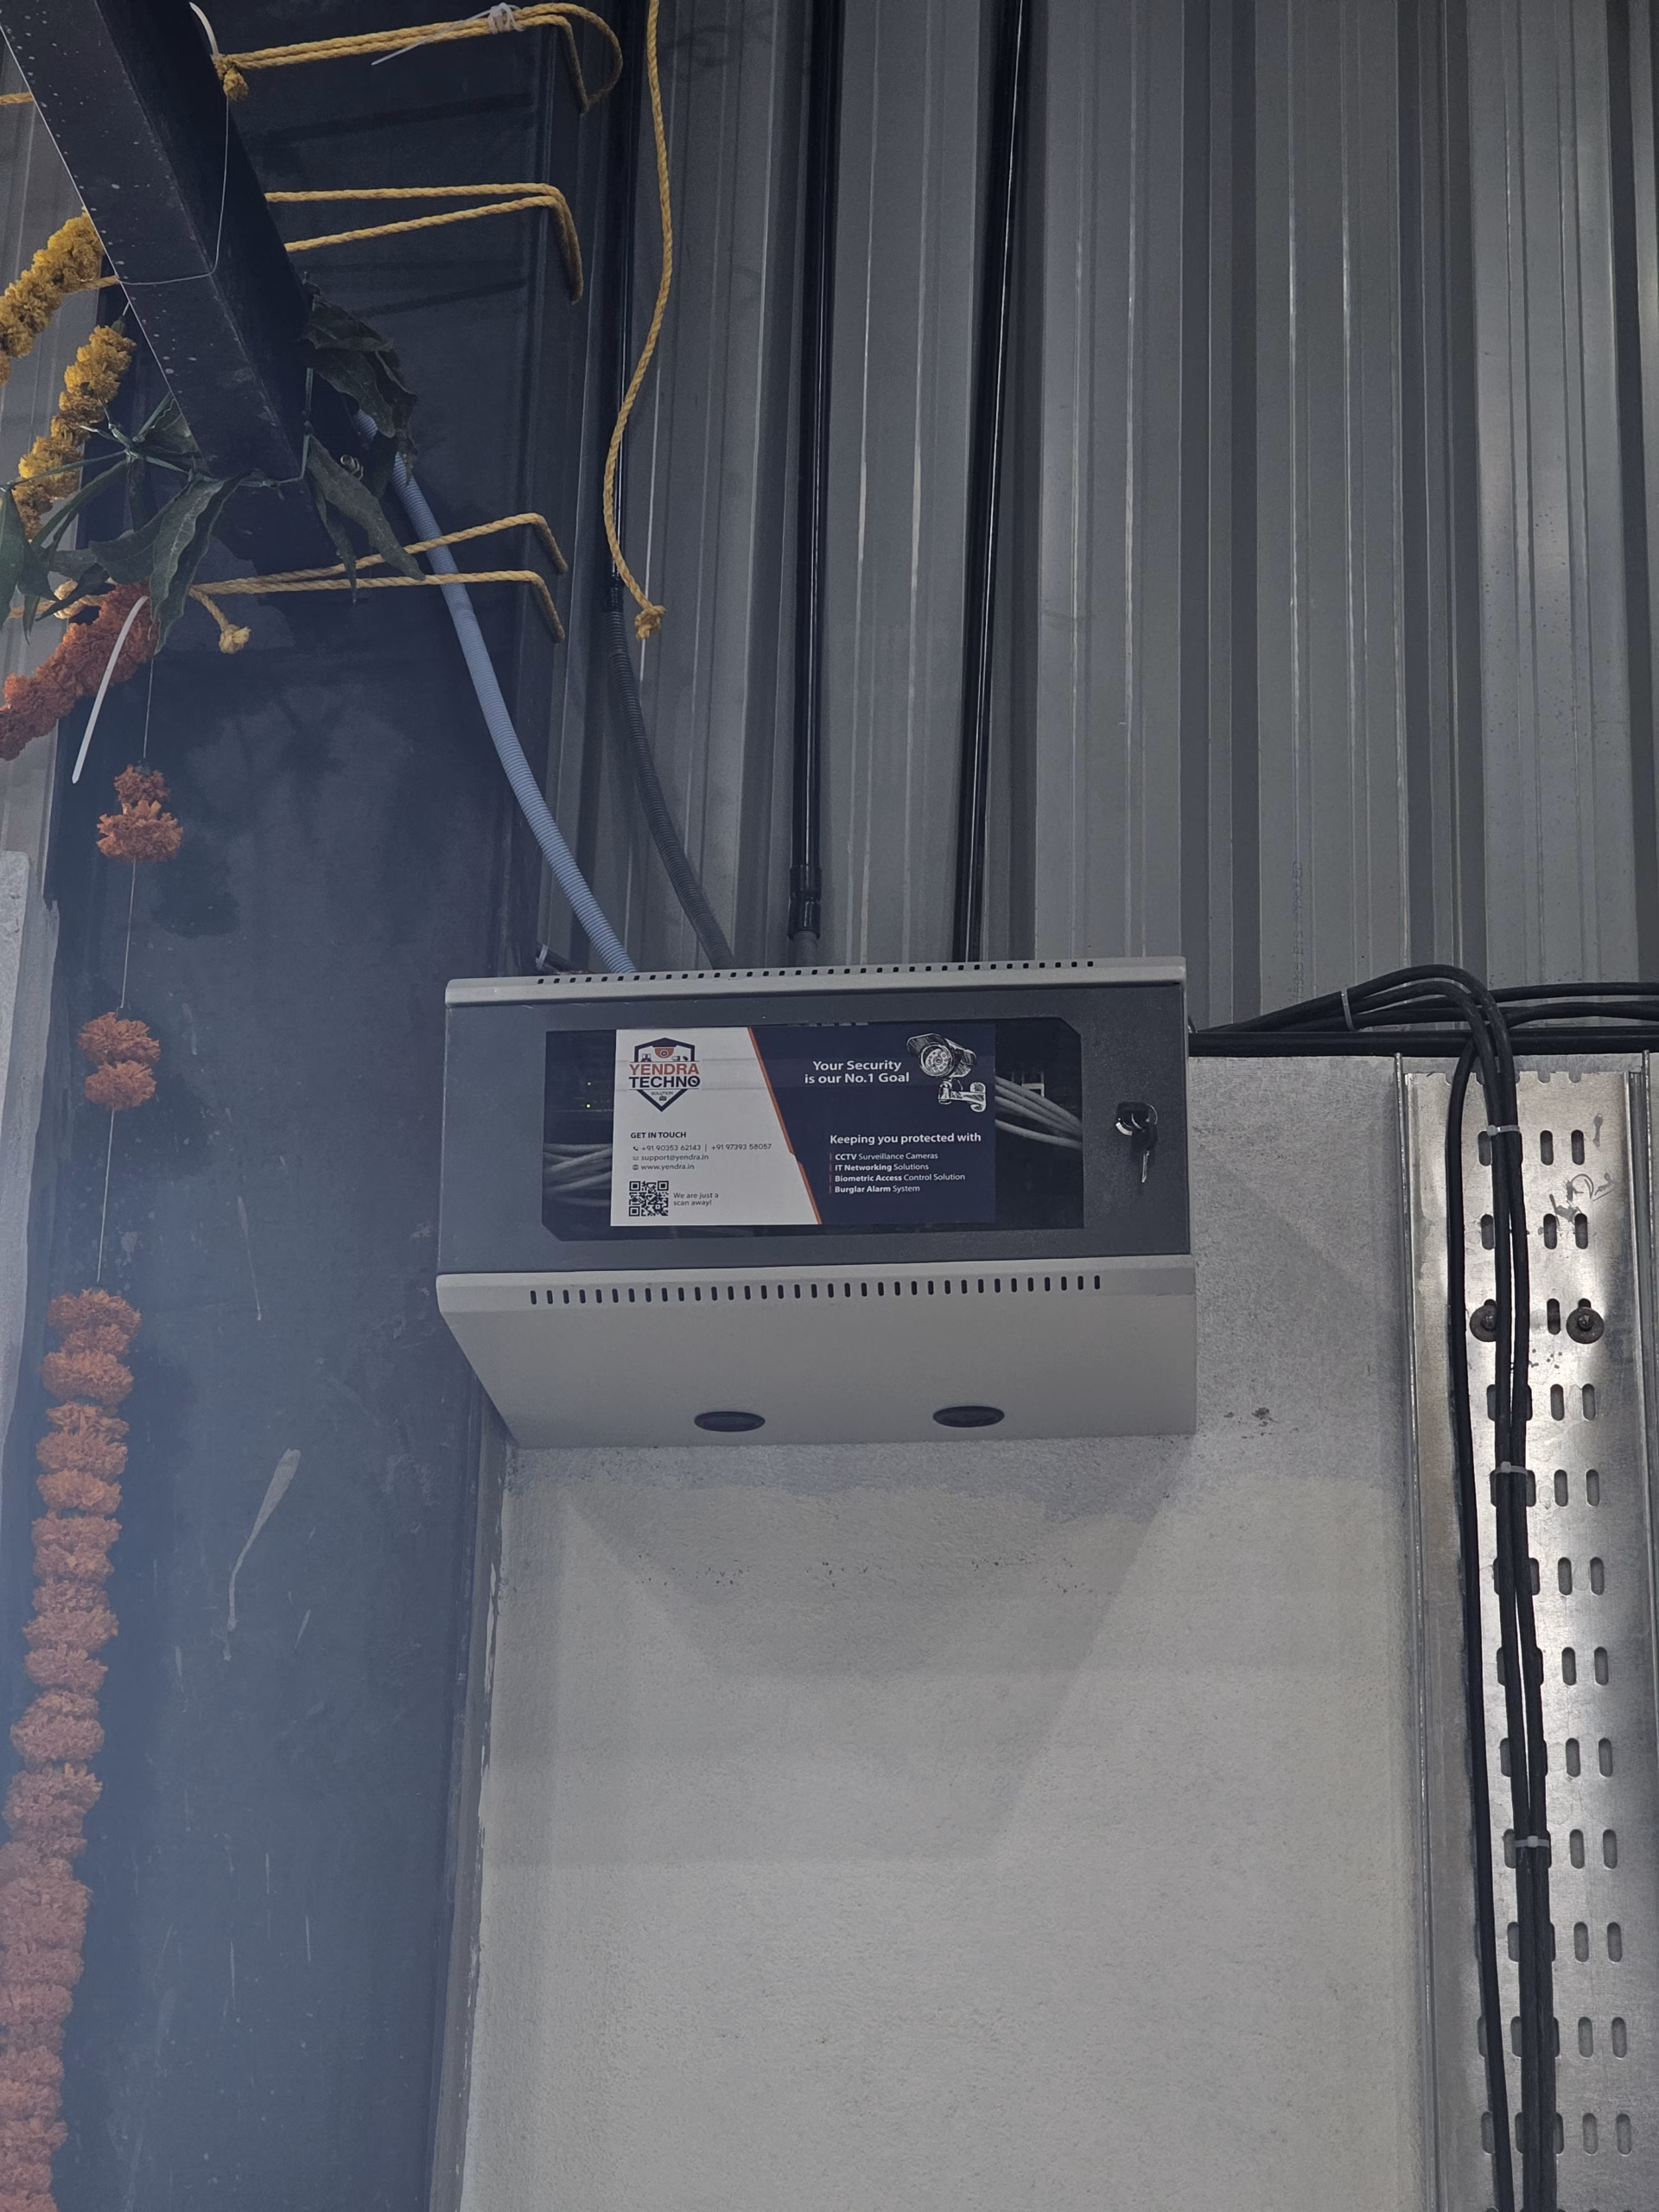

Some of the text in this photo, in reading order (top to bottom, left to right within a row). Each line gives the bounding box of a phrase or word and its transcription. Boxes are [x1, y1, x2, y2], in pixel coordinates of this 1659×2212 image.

[629, 1063, 699, 1075] YENDRA
[813, 1059, 901, 1071] Your Security
[629, 1075, 701, 1089] TECHNO
[804, 1072, 909, 1084] is our No.1 Goal
[830, 1133, 981, 1145] Keeping you protected with
[641, 1154, 709, 1162] support@yendra.in
[835, 1185, 865, 1194] Burglar
[893, 1185, 920, 1193] System
